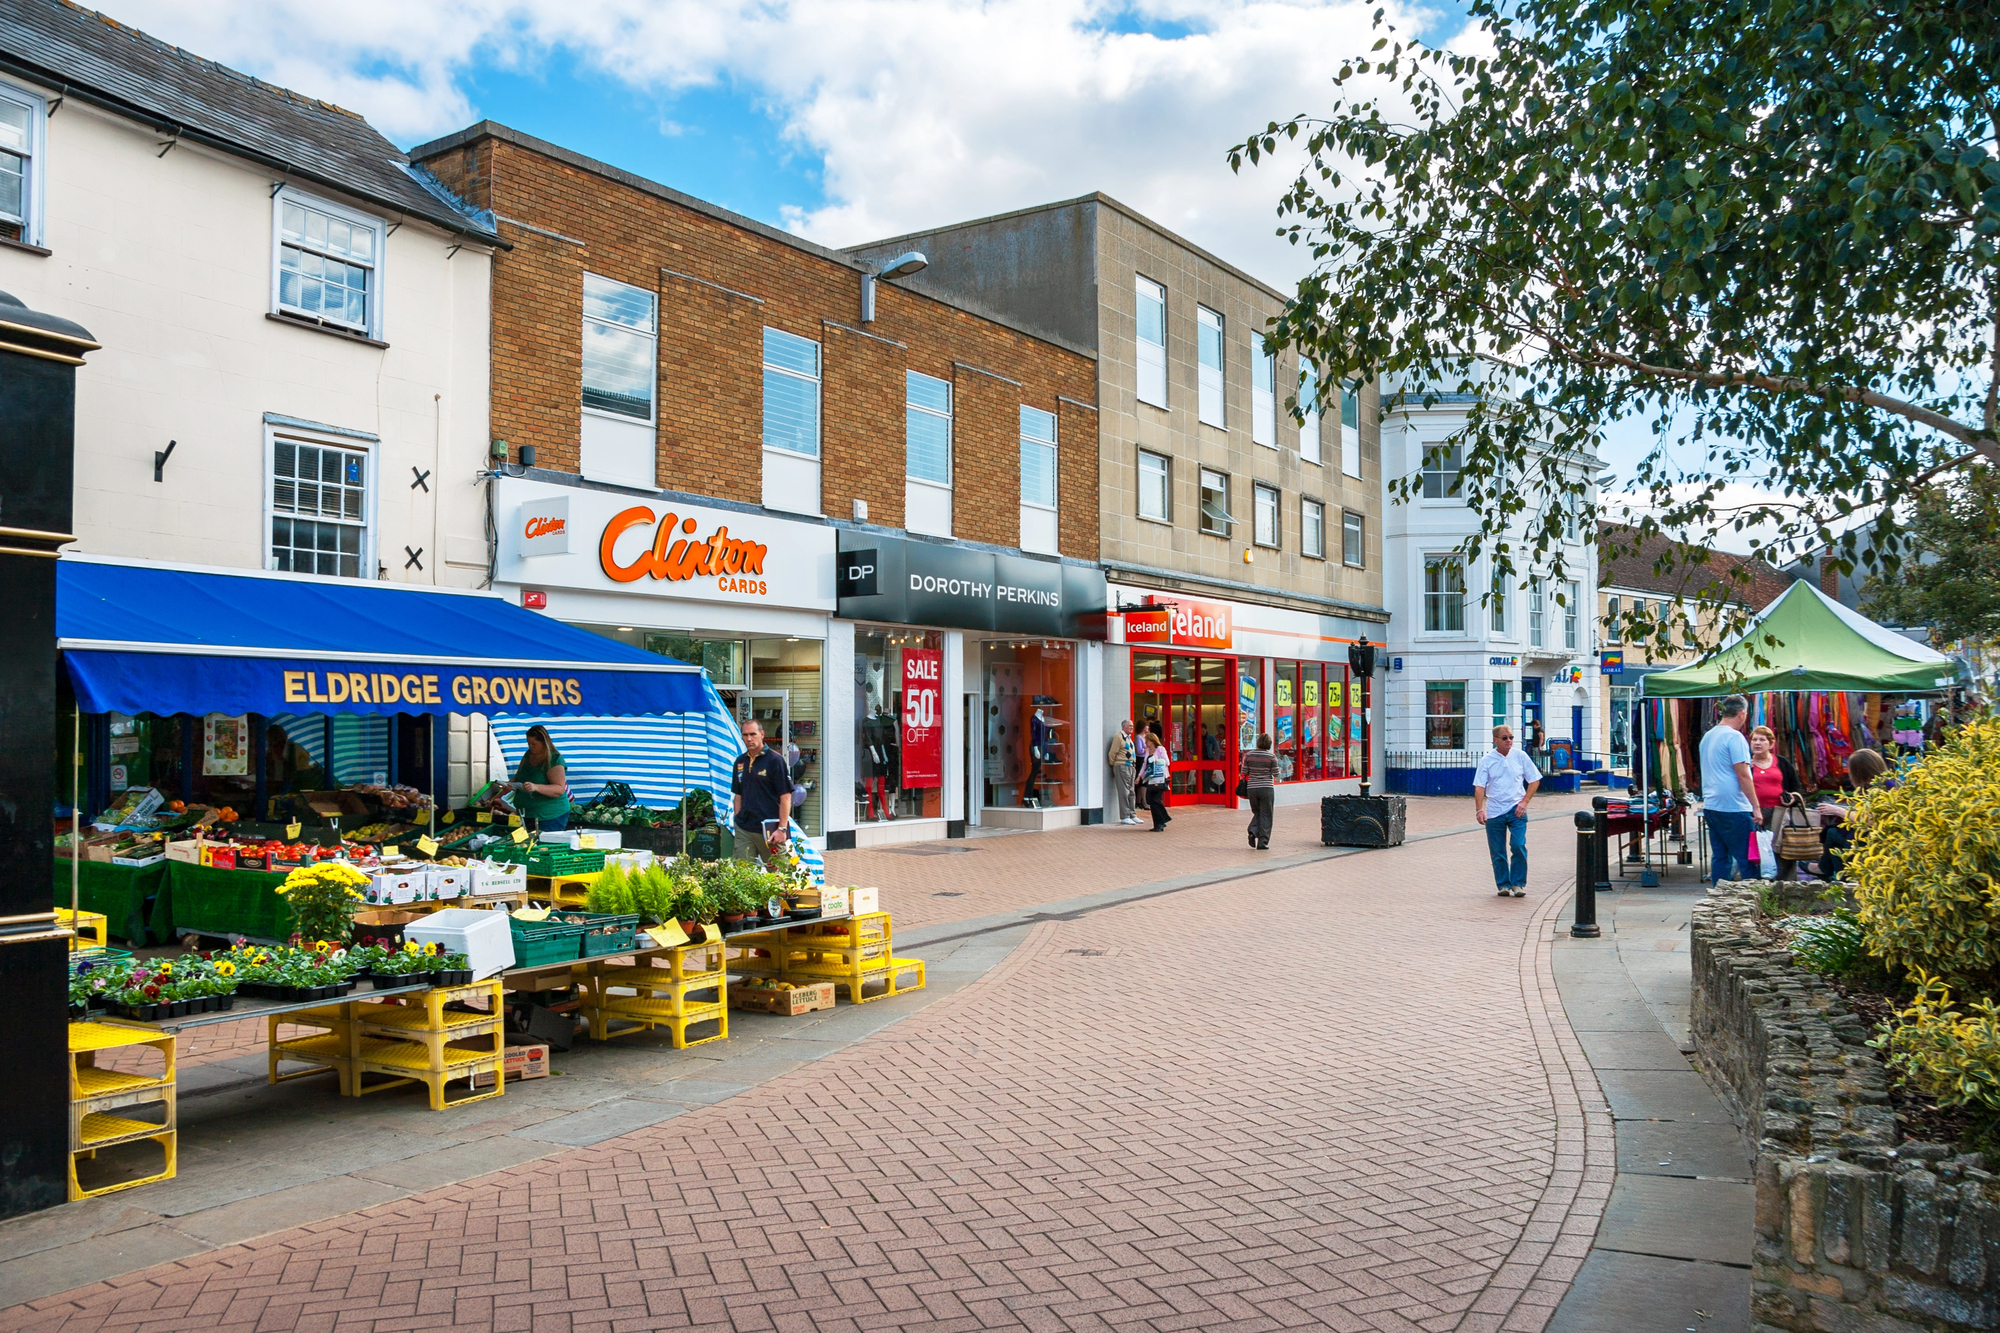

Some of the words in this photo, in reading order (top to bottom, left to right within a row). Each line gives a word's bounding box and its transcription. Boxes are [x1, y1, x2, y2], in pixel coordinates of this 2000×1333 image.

[525, 516, 565, 539] Clinton
[599, 505, 767, 583] Clinton
[849, 564, 875, 580] DP
[718, 576, 767, 595] CARDS
[910, 573, 992, 599] DOROTHY
[996, 585, 1059, 607] PERKINS
[1127, 620, 1167, 633] Iceland
[1171, 608, 1226, 640] eland
[1489, 656, 1512, 666] CORAL
[906, 659, 938, 680] SALE
[283, 670, 441, 704] ELDRIDGE
[452, 675, 582, 705] GROWERS
[1279, 685, 1291, 702] 75p
[1305, 686, 1317, 702] 75p
[1329, 687, 1341, 703] 75p
[1351, 688, 1361, 703] 75
[906, 727, 930, 743] OFF
[792, 989, 818, 1000] ICEBERG
[792, 996, 818, 1005] LETTUCE
[504, 1051, 526, 1059] COOLED
[504, 1056, 525, 1064] LETTUCE
